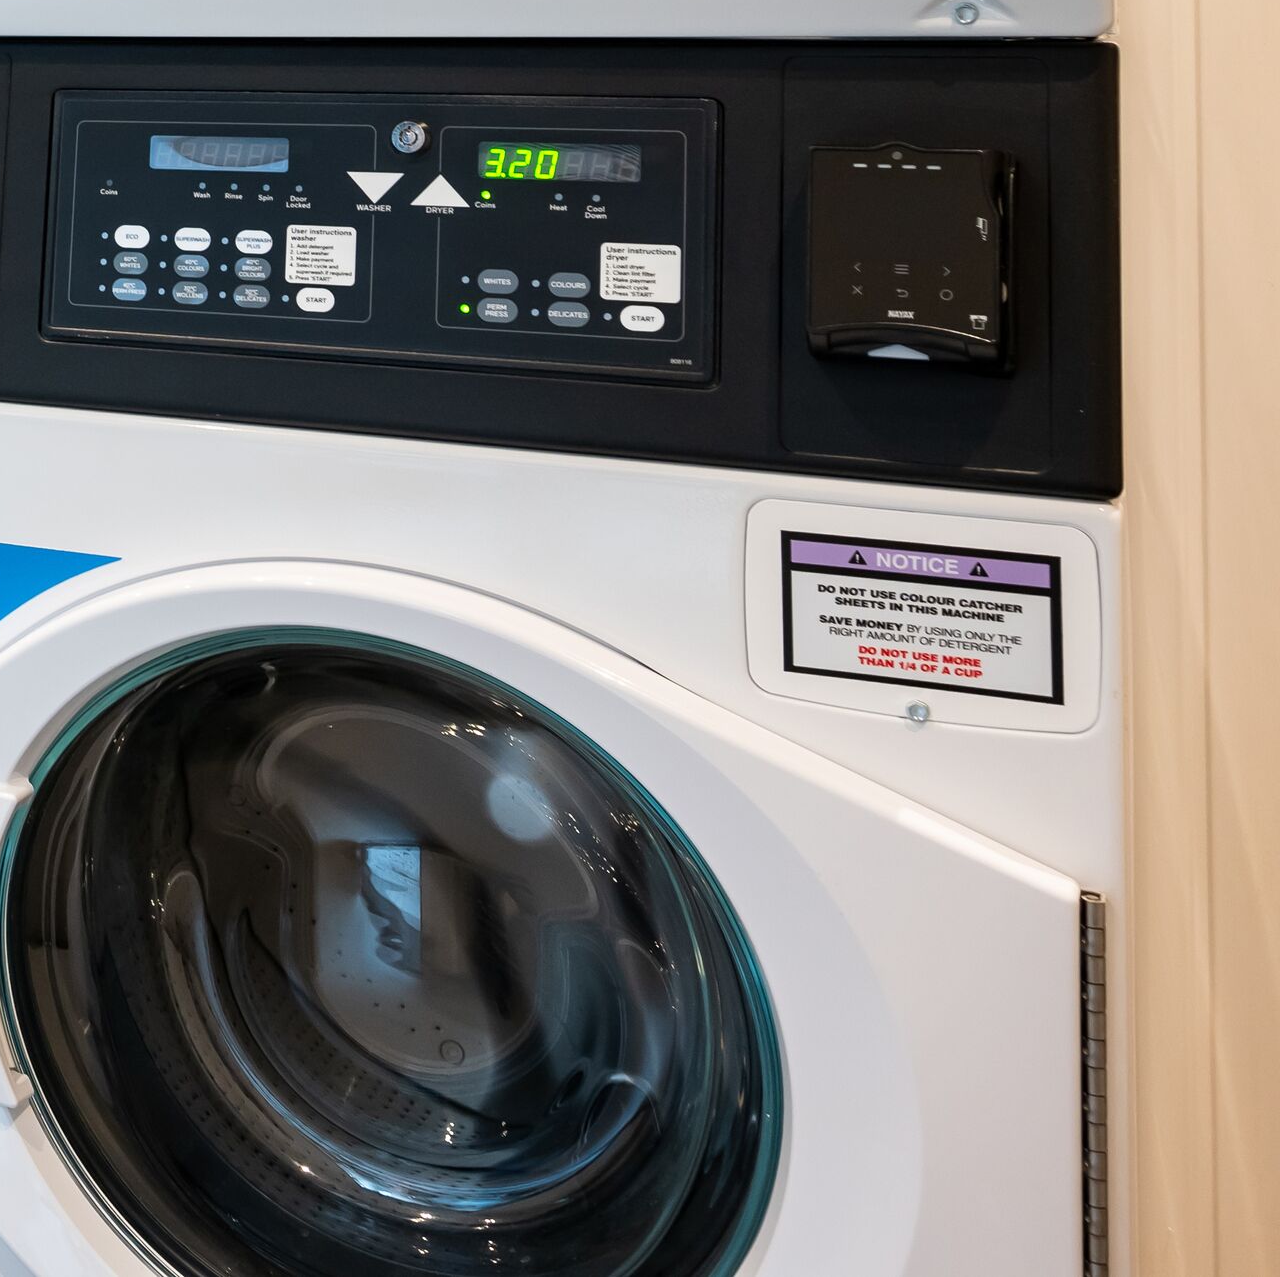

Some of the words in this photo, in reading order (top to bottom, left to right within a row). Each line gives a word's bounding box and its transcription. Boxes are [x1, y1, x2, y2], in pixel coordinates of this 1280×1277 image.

[485, 149, 558, 179] 3.20
[356, 202, 391, 211] WASHER
[474, 200, 497, 209] Coins
[549, 203, 568, 212] Heat
[424, 205, 456, 214] DRYER
[483, 277, 512, 286] WHITES
[550, 280, 587, 290] COLOURS
[305, 296, 327, 304] START
[547, 309, 589, 319] DELICATES
[888, 310, 914, 319] NAYAX
[631, 315, 655, 323] START
[875, 551, 959, 575] NOTICE
[818, 584, 836, 593] DO
[840, 587, 867, 596] NOT
[870, 590, 897, 600] USE
[899, 593, 955, 606] COLOUR
[959, 599, 1023, 614] CATCHER
[835, 597, 884, 610] SHEETS
[889, 602, 900, 612] IN
[906, 604, 938, 616] THIS
[942, 607, 1005, 622] MACHINE
[859, 646, 877, 655] DO
[881, 648, 908, 658] NOT
[912, 652, 938, 662] USE
[942, 656, 981, 667] MORE
[858, 656, 895, 668] THAN
[899, 662, 916, 670] 1/4
[921, 664, 938, 672] OF
[954, 668, 983, 678] CUP
